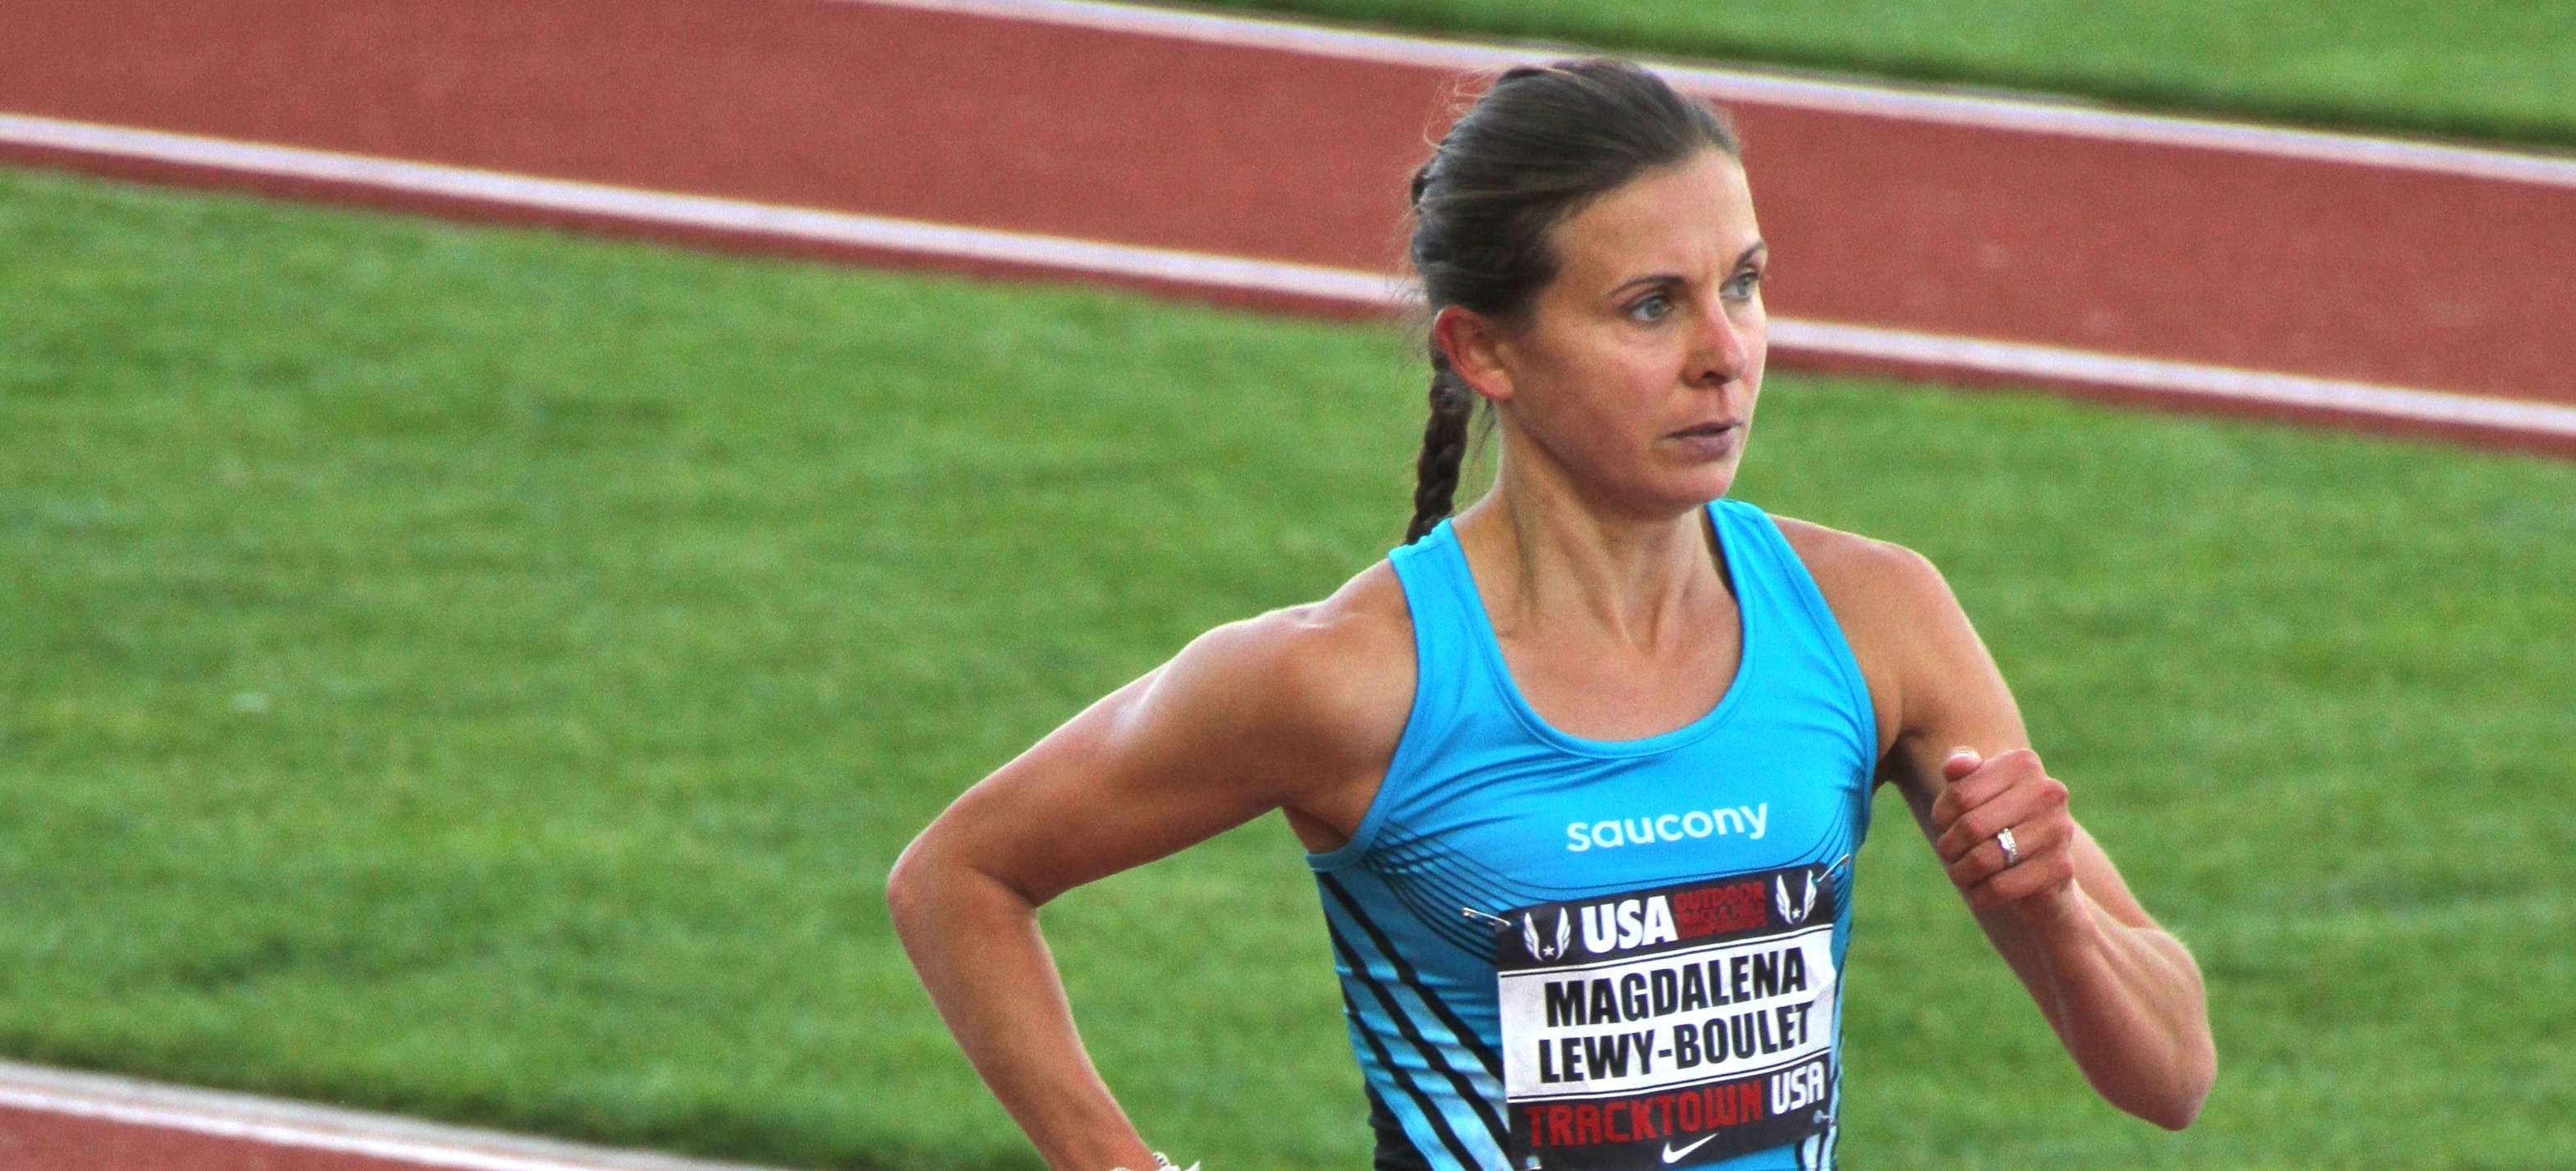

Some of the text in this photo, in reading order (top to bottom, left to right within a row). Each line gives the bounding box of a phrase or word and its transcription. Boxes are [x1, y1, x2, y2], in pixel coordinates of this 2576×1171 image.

[1567, 803, 1767, 852] saucony
[1581, 894, 1678, 954] USA
[1673, 881, 1765, 910] OUTDOOR
[1544, 946, 1807, 1028] MAGDALENA
[1539, 1001, 1814, 1084] LEWY-BOULET
[1524, 1061, 1825, 1147] TRACKTOWN USA
